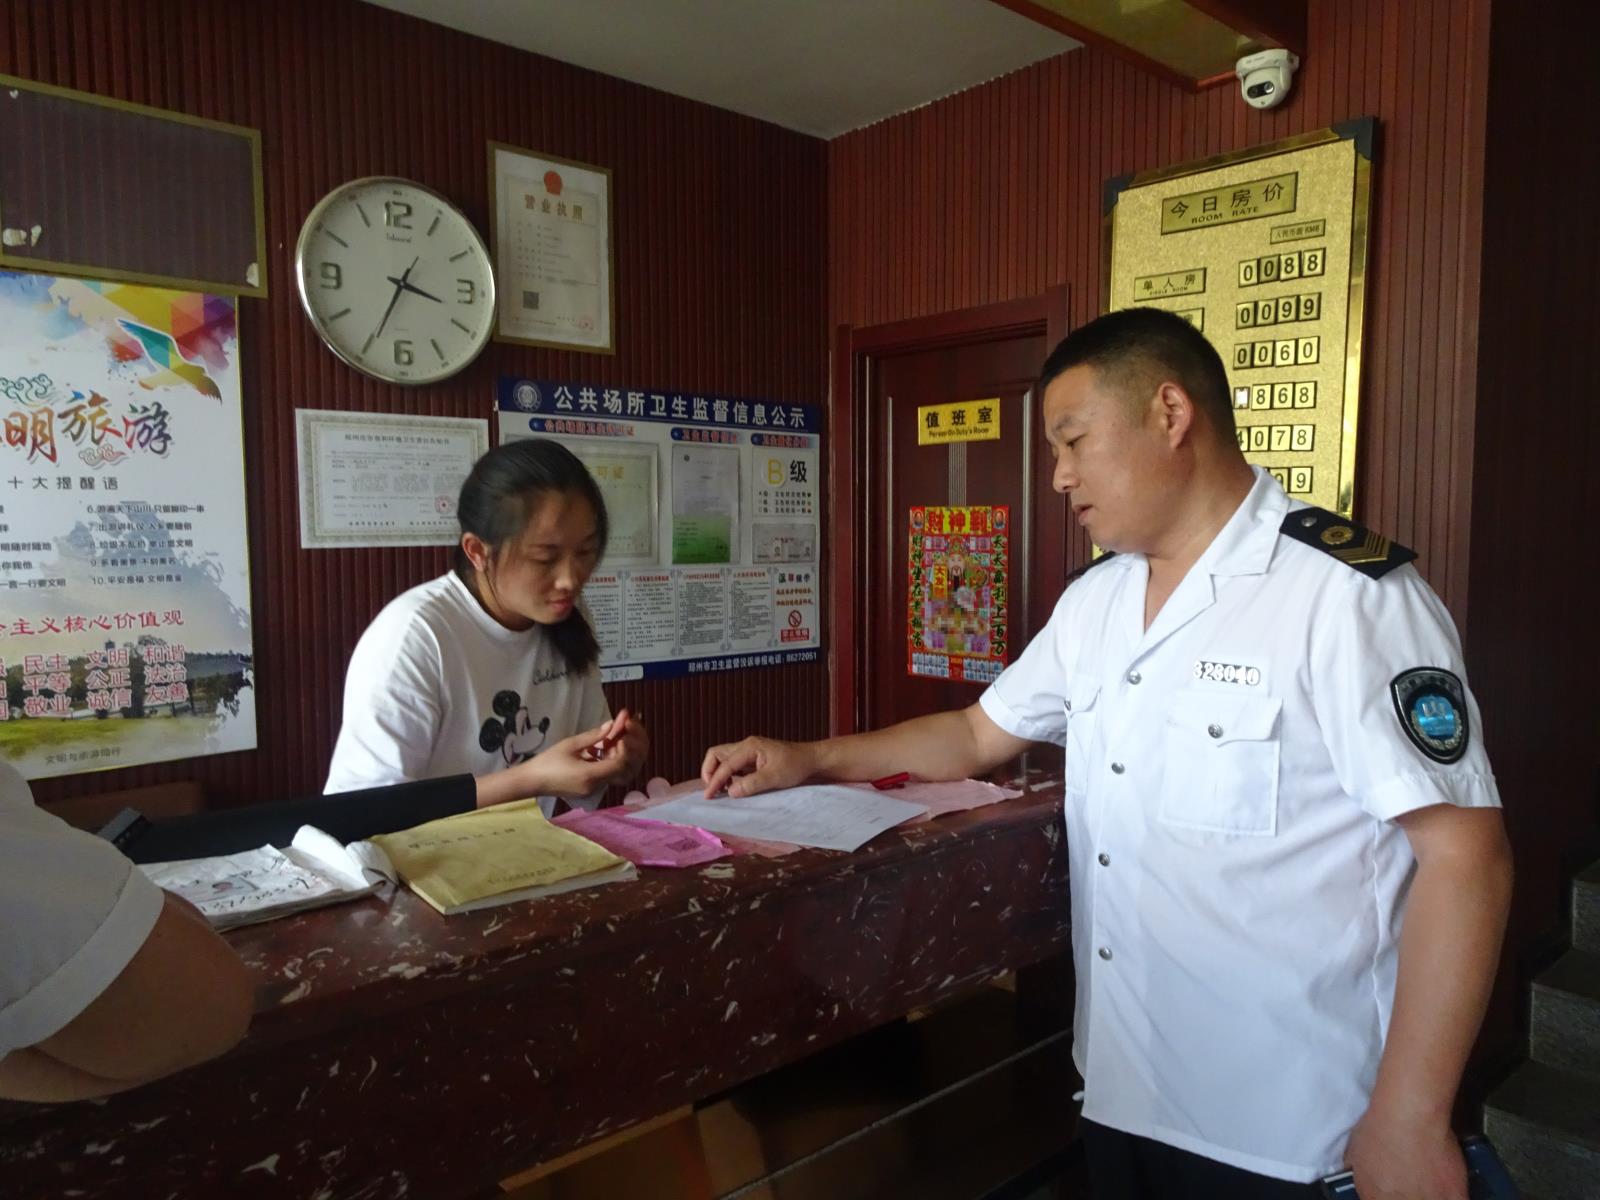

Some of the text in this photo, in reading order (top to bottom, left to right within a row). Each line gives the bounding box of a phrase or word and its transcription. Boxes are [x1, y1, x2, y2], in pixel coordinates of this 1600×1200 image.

[524, 193, 584, 221] 营业执照
[1170, 182, 1285, 219] 今日房价
[385, 200, 413, 229] 12
[1191, 206, 1259, 224] ROOM RATE
[319, 262, 342, 290] 9
[1242, 253, 1319, 282] 0088
[457, 279, 475, 304] 3
[1142, 274, 1196, 291] 单人房
[1240, 299, 1314, 323] 0099
[394, 340, 414, 366] 6
[1237, 342, 1313, 364] 0060
[553, 385, 806, 428] 公共场所卫生监督信息公示
[1256, 386, 1309, 405] 868
[925, 406, 993, 428] 值班室
[8, 476, 119, 491] 十大提醒语
[25, 644, 186, 674] 民主 文明 和谐
[24, 664, 187, 695] 平等 公正 法治
[25, 683, 188, 717] 敬业 诚信 友善
